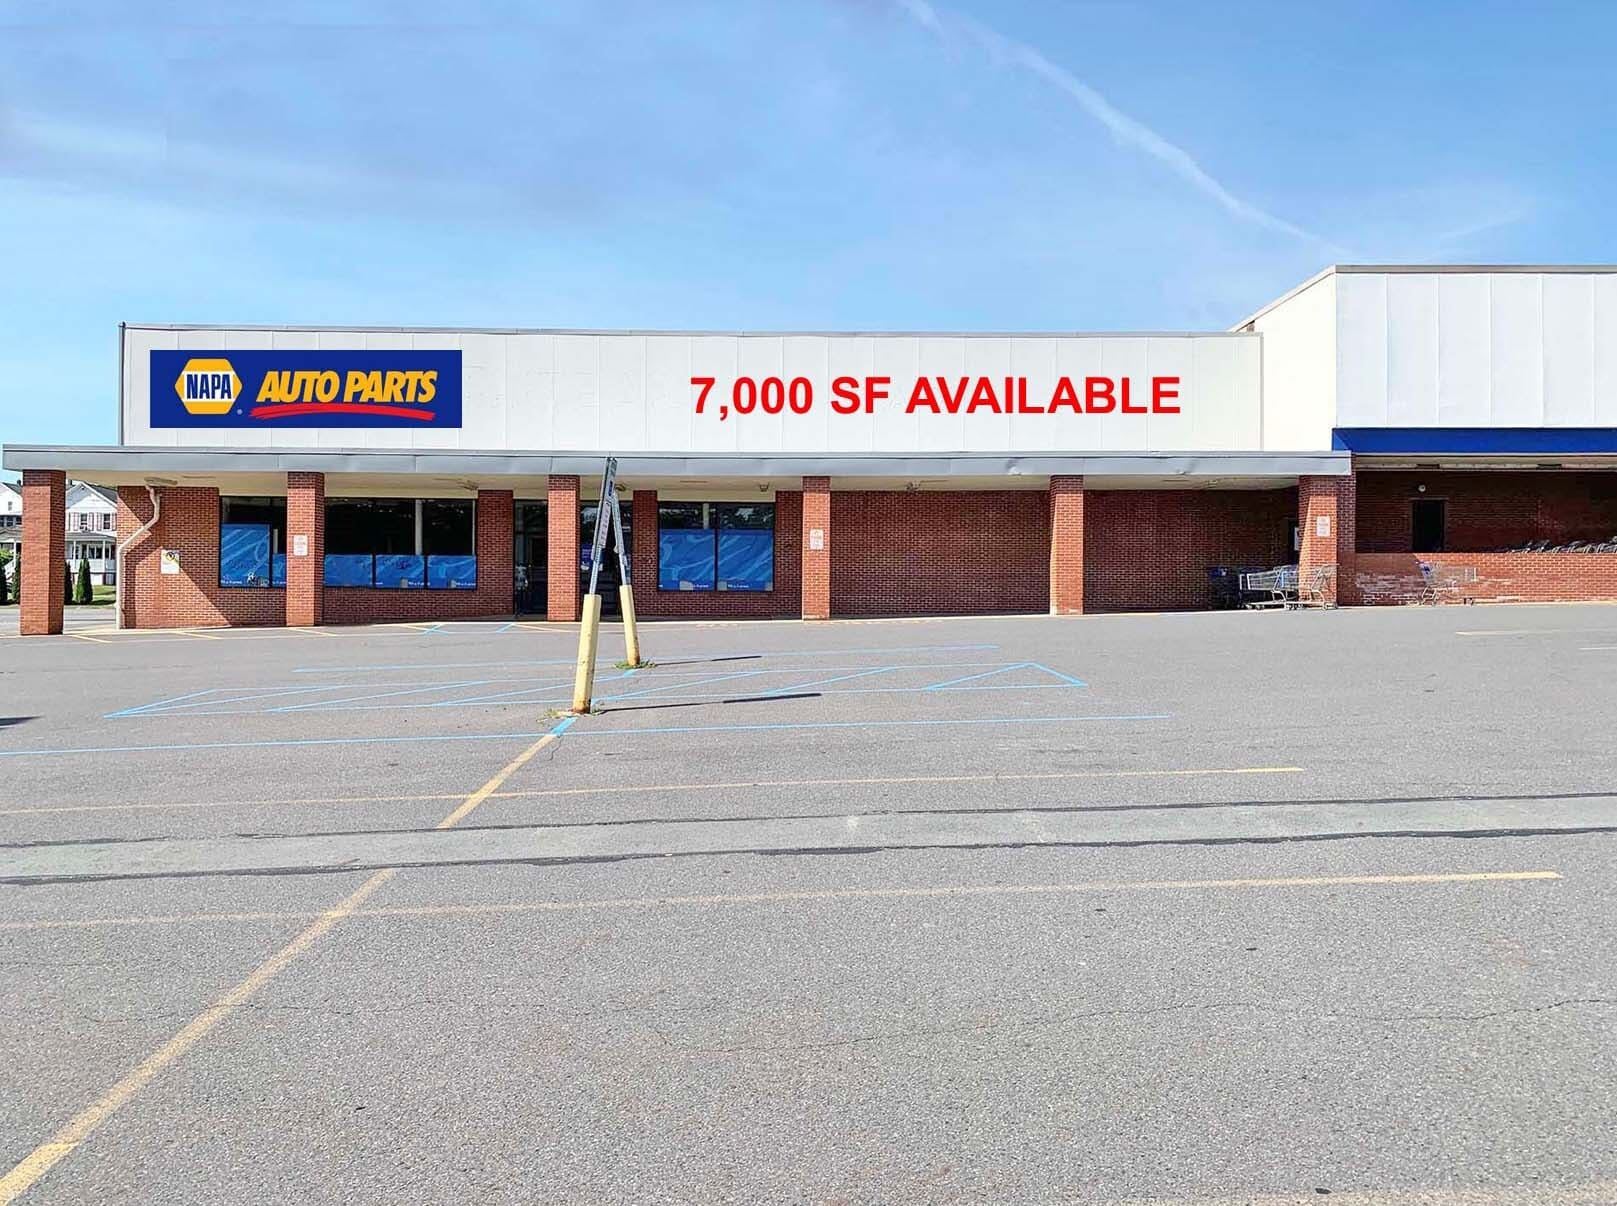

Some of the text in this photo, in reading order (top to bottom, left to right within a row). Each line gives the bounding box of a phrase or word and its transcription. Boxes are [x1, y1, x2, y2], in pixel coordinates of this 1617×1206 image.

[187, 370, 438, 403] NAPA AUTO PARTS
